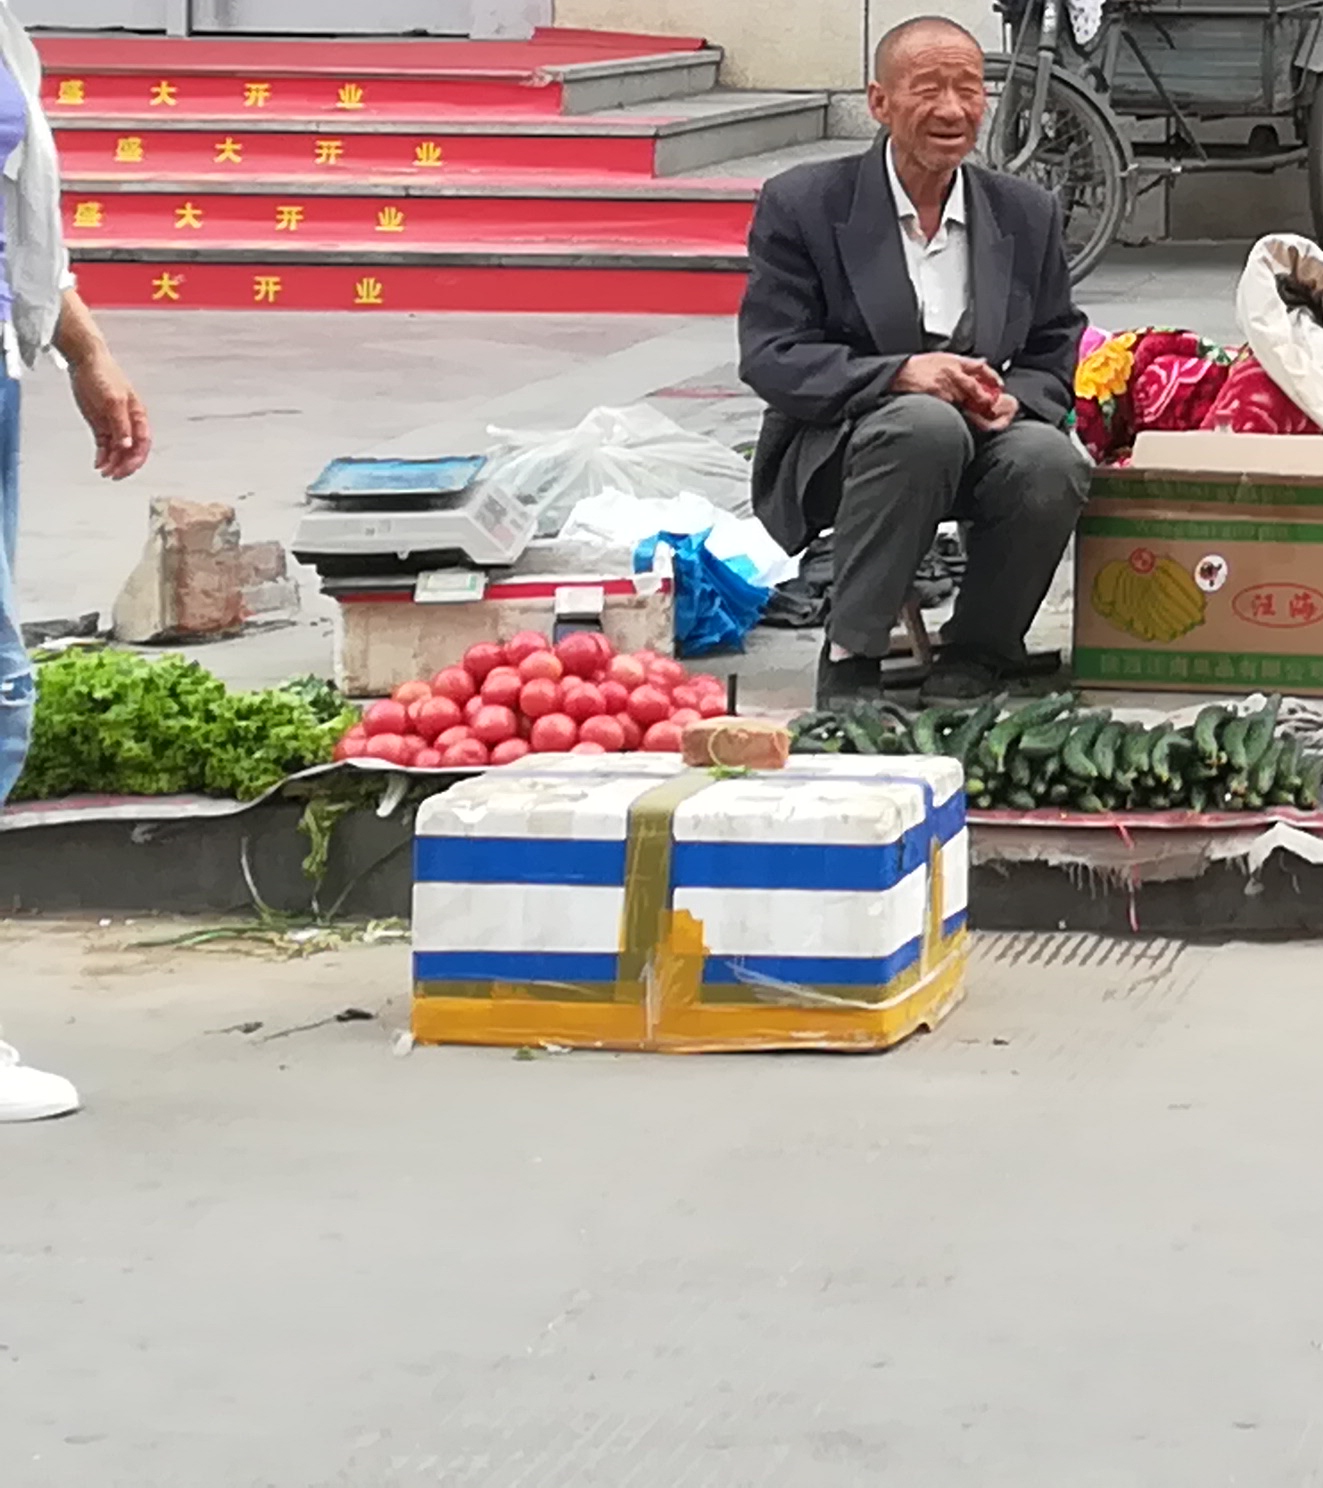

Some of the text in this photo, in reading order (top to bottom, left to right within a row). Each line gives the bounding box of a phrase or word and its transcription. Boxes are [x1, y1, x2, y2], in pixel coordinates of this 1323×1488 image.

[57, 80, 364, 110] 盛大开业
[115, 136, 443, 168] 盛大开业
[73, 200, 405, 233] 盛大开业
